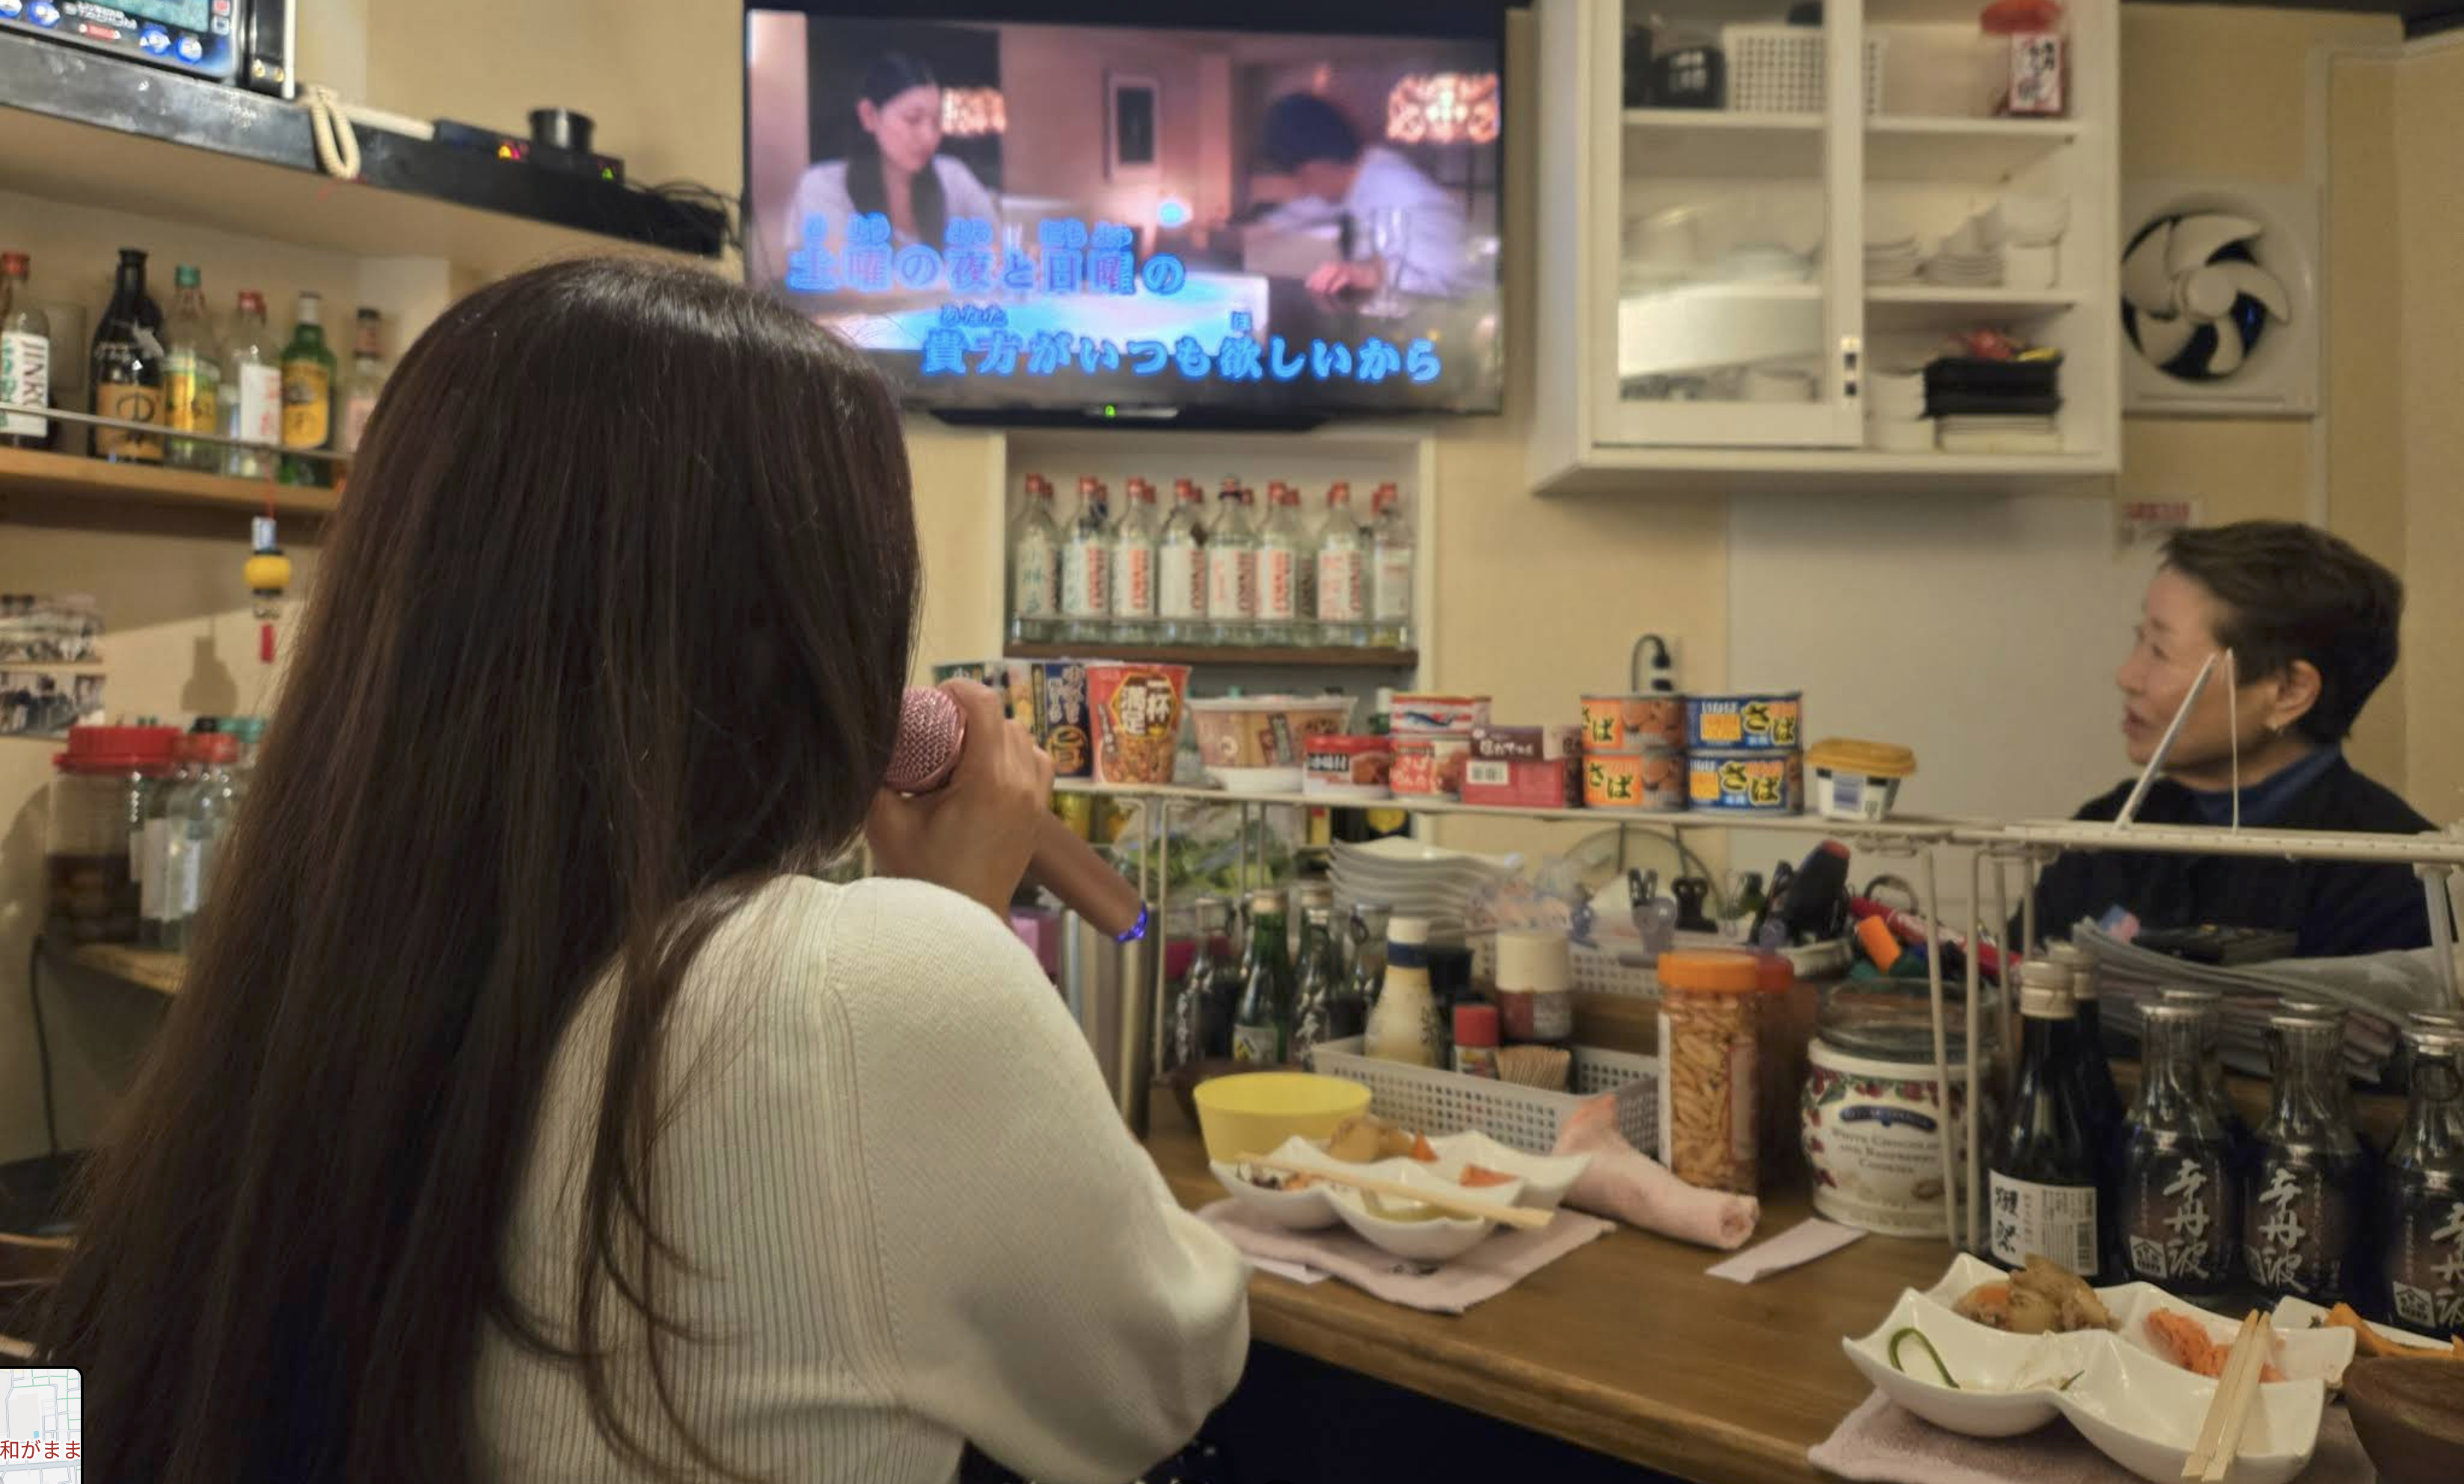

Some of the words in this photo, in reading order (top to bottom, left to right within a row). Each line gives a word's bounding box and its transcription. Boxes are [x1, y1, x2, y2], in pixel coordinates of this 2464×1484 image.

[785, 242, 1186, 295] 土曜の夜と日曜の
[940, 305, 1008, 325] あなた
[922, 326, 1442, 382] 貴方がいつも欲しいから
[1743, 702, 1795, 744] さば
[1590, 761, 1634, 800] さば
[1721, 762, 1782, 805] さば
[2162, 1159, 2210, 1278] 辛丹波
[2258, 1168, 2309, 1293] 辛丹波
